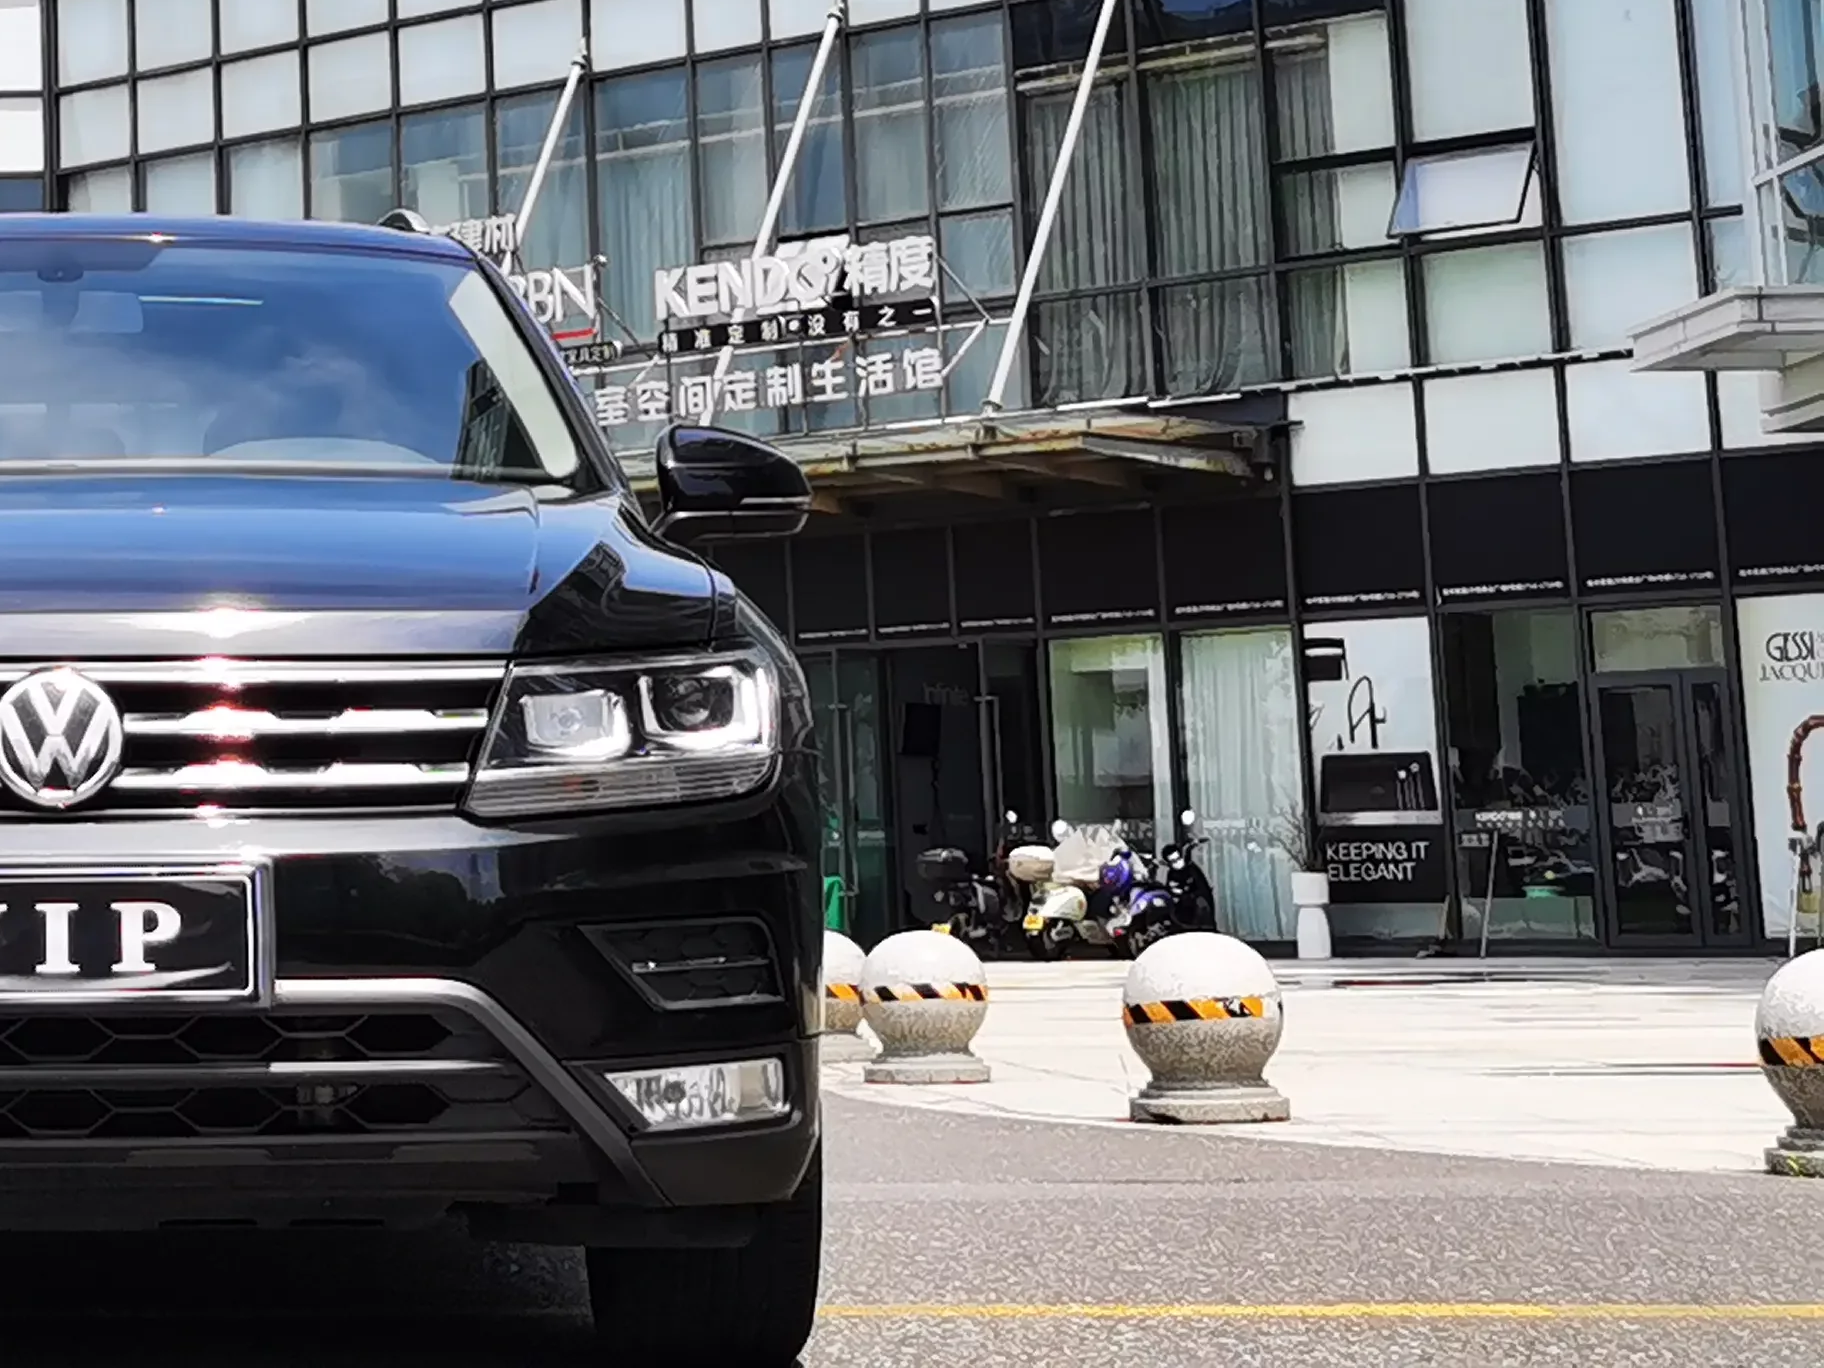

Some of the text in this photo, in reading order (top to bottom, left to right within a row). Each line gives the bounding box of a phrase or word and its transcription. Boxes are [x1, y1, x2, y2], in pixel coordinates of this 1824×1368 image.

[843, 235, 936, 297] 精度
[1326, 841, 1430, 861] KEEPING IT
[1327, 862, 1416, 882] ELEGANT
